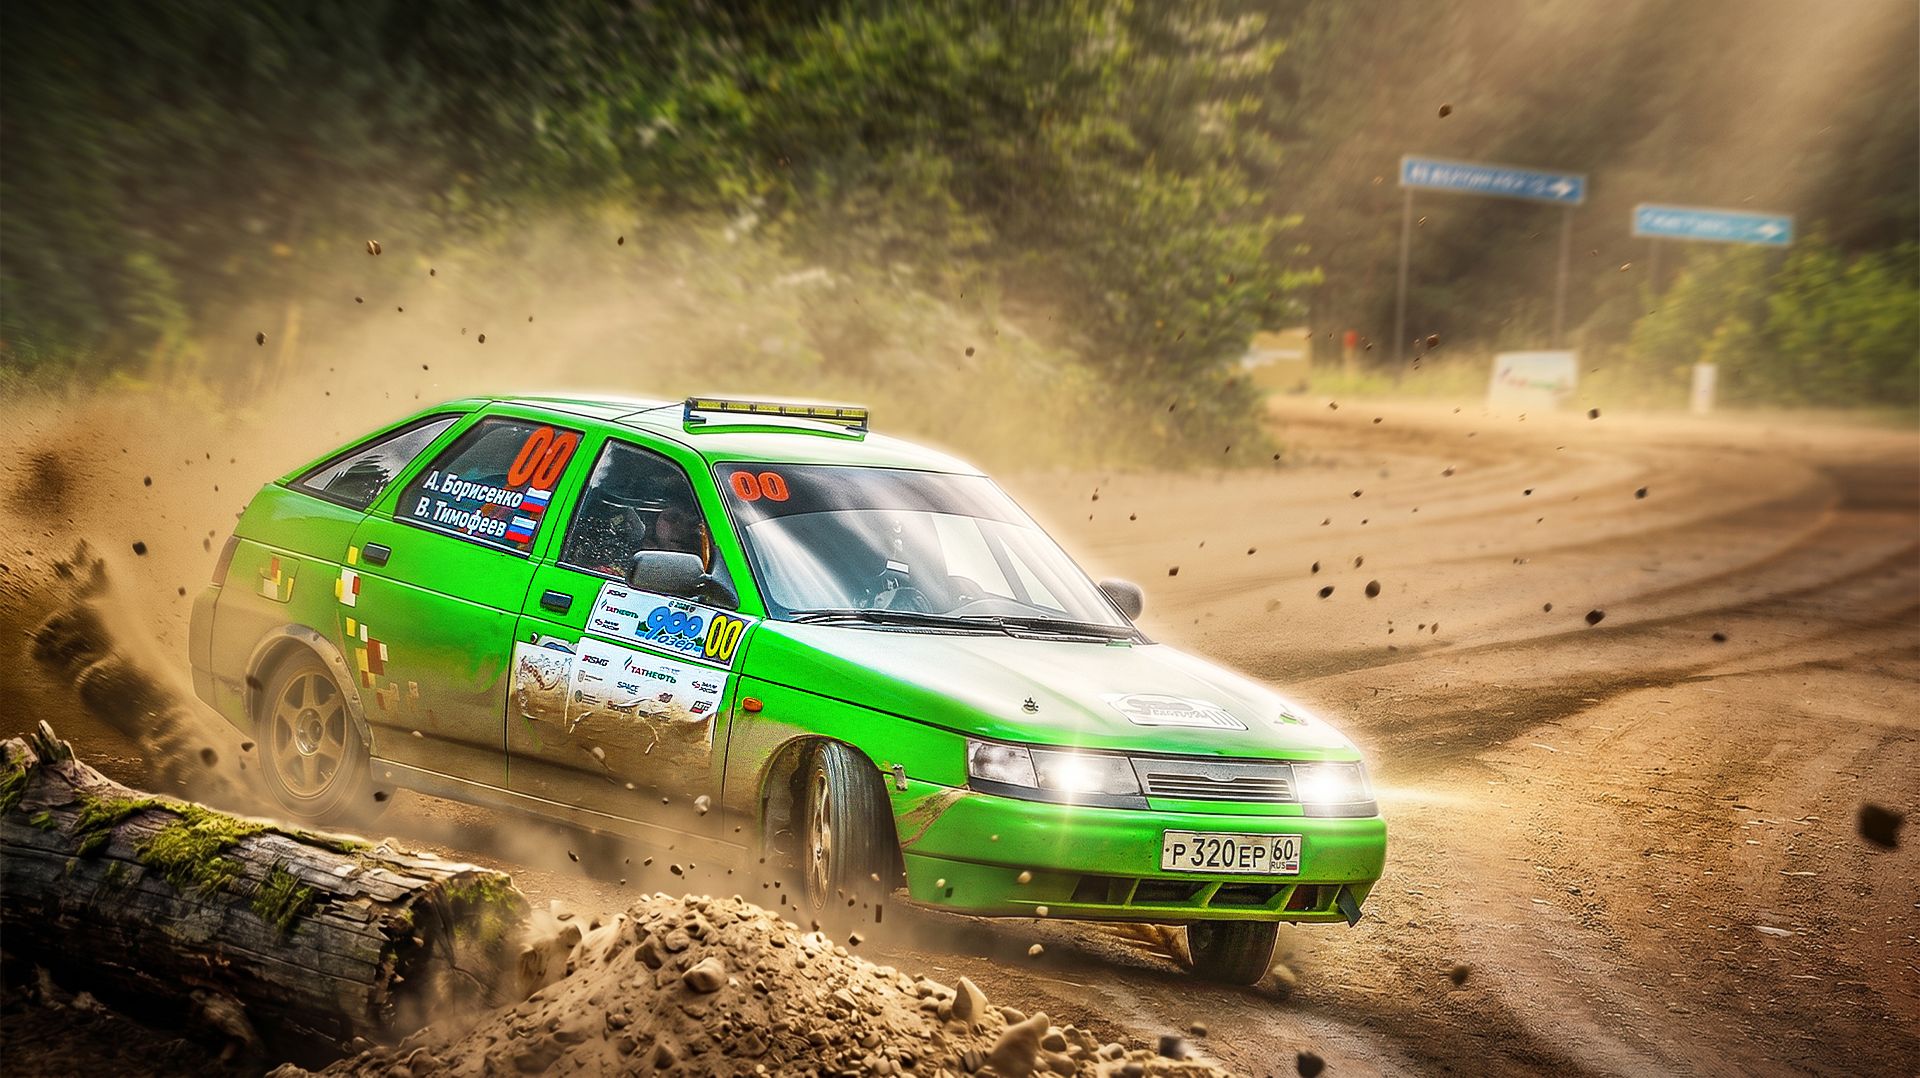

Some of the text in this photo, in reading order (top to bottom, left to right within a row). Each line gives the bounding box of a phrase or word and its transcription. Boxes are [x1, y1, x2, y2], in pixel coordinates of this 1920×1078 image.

[507, 426, 578, 490] 00
[423, 470, 524, 508] А. Борисенко
[729, 471, 790, 502] 00
[414, 496, 507, 537] В. Тимофеев
[645, 606, 704, 640] 900
[704, 615, 745, 661] 00
[631, 665, 677, 684] ТАТНЕФТЬ
[1271, 861, 1286, 870] RUS
[1272, 839, 1294, 861] 60
